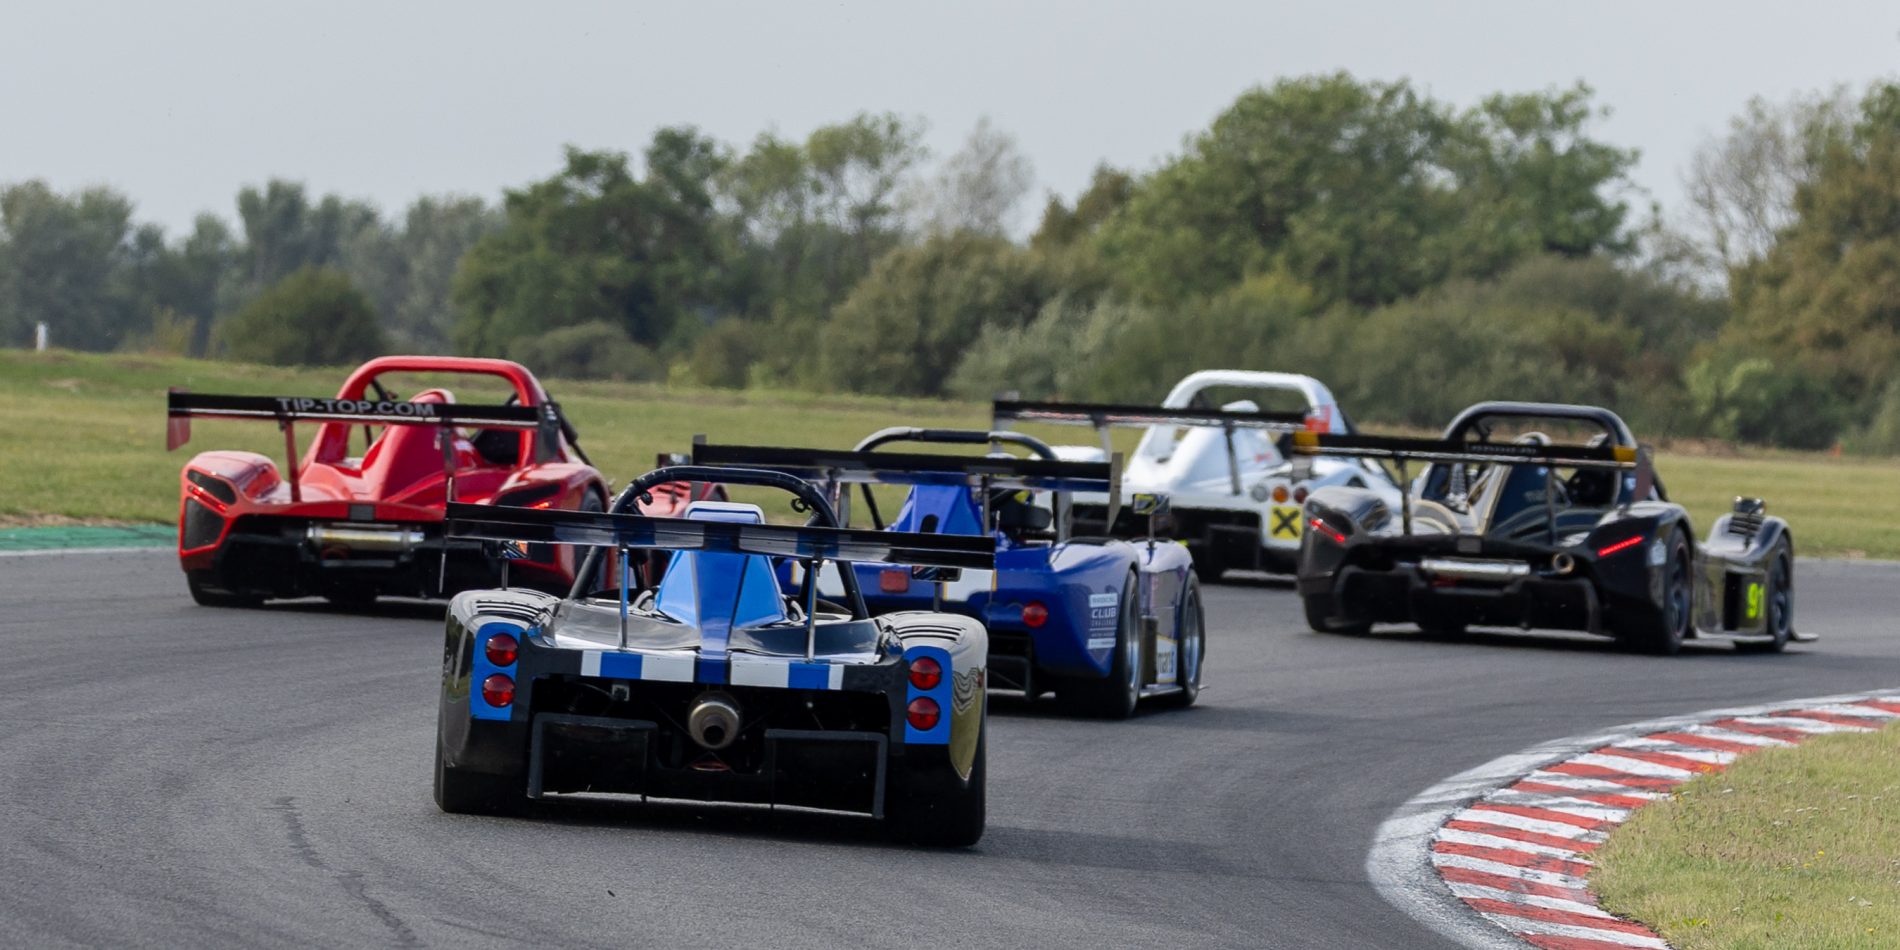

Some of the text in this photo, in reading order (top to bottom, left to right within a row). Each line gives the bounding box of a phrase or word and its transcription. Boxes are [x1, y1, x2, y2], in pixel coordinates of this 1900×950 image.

[276, 398, 435, 415] TIP-TOP.COM
[1746, 582, 1765, 619] 91
[1091, 607, 1117, 619] CLUB
